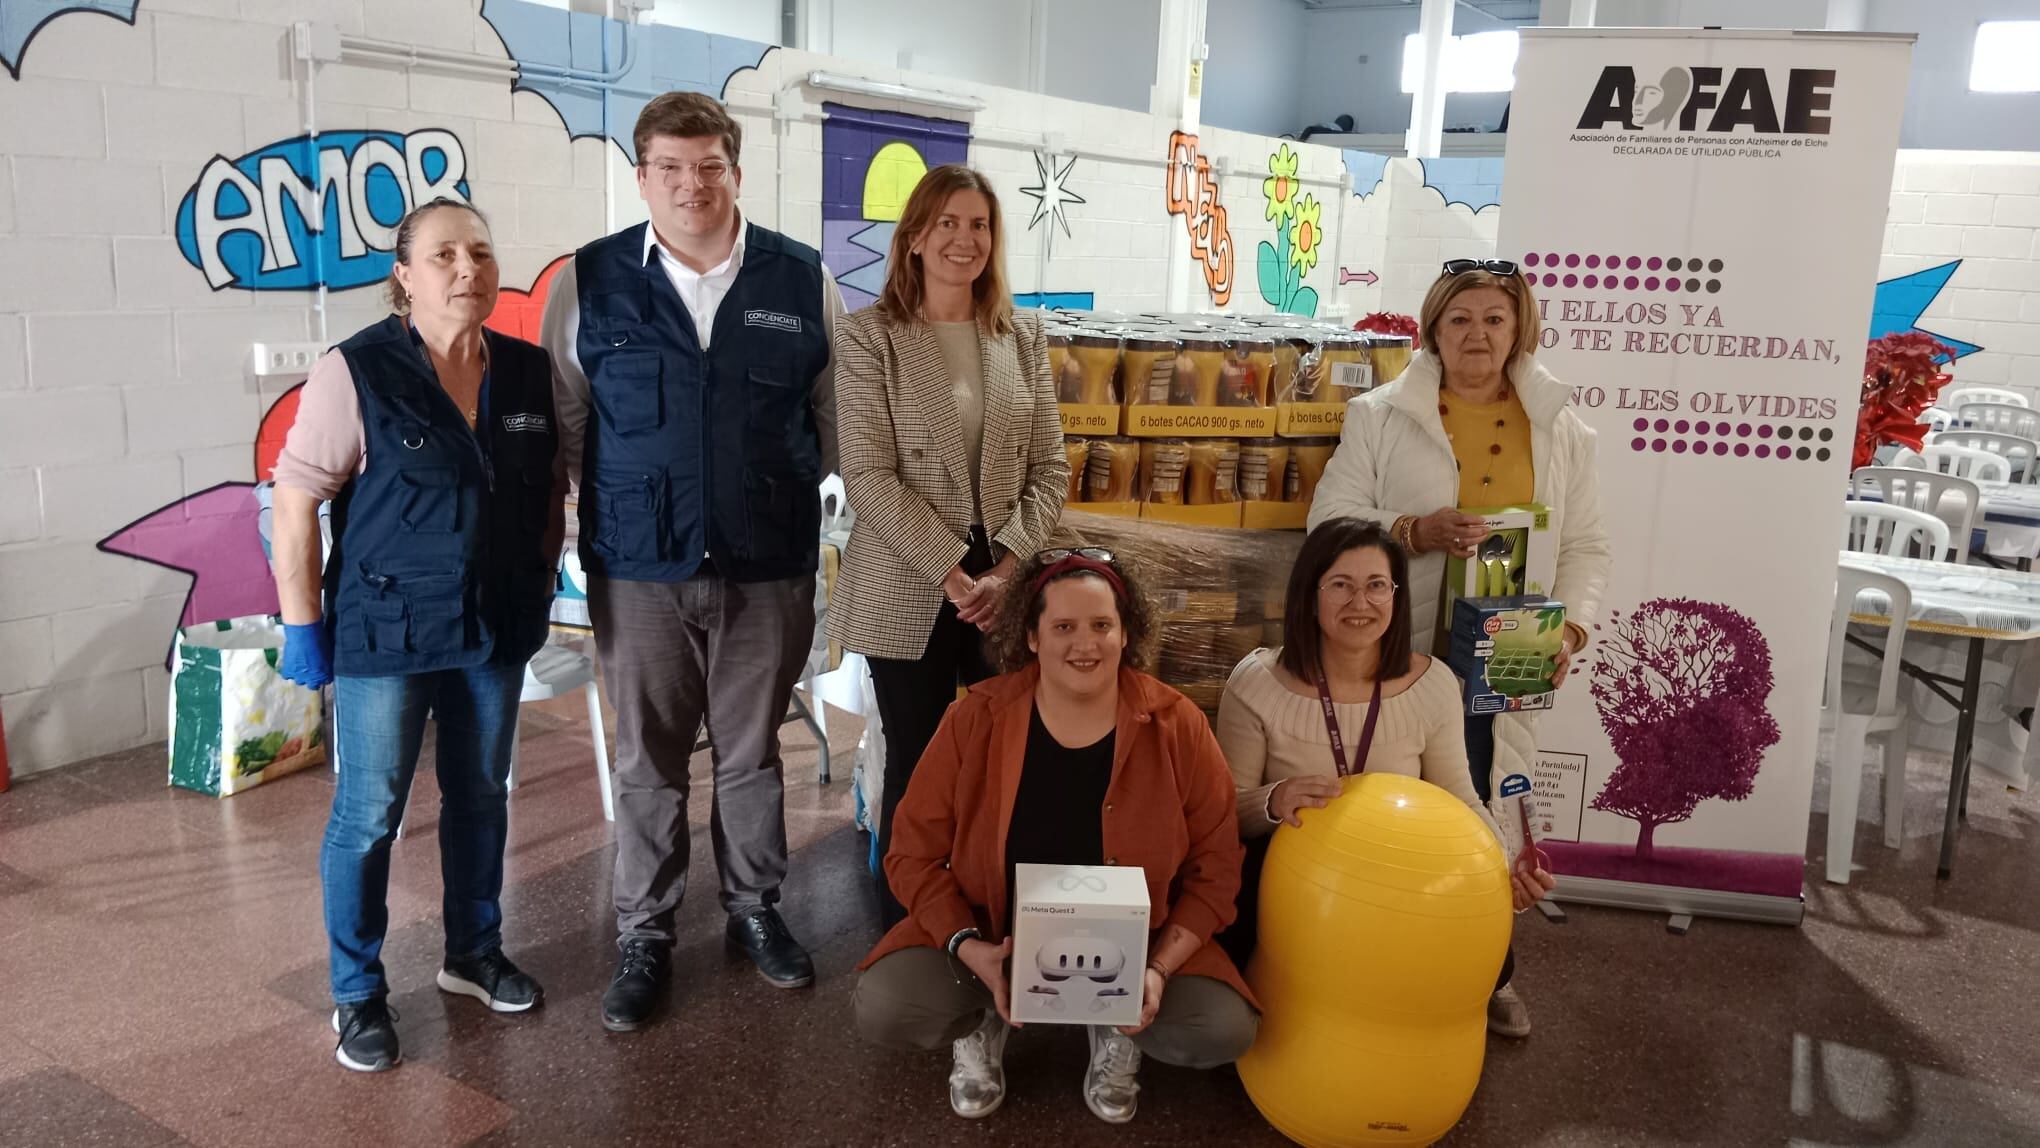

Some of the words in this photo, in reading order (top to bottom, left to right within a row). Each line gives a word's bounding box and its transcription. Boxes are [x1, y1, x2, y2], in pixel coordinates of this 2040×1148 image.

[1576, 66, 1836, 134] AFAE
[1570, 133, 1614, 143] Asociación
[1616, 134, 1627, 143] de
[1629, 134, 1672, 144] Familiares
[1687, 135, 1727, 146] Personas
[1746, 137, 1790, 146] Alzheimer
[1791, 138, 1802, 146] de
[1804, 138, 1828, 147] Elche
[1613, 146, 1673, 155] DECLARADA
[1674, 147, 1688, 155] DE
[1691, 148, 1736, 157] UTILIDAD
[193, 129, 470, 292] AMOR
[1538, 299, 1550, 321] I
[1560, 299, 1668, 325] ELLOS
[1680, 304, 1725, 328] YA
[1539, 327, 1559, 349] O
[1570, 328, 1612, 351] TE
[1621, 330, 1841, 365] RECUERDAN,
[1615, 387, 1679, 412] LES
[1690, 391, 1837, 420] OLVIDES
[1086, 415, 1107, 426] neto
[1140, 415, 1146, 427] 6
[1148, 415, 1173, 427] botes
[1175, 416, 1209, 428] CACAO
[1211, 416, 1228, 427] 900
[1245, 418, 1265, 429] neto
[1297, 411, 1322, 423] botes
[1324, 411, 1345, 424] CAC
[1534, 770, 1562, 780] licante)
